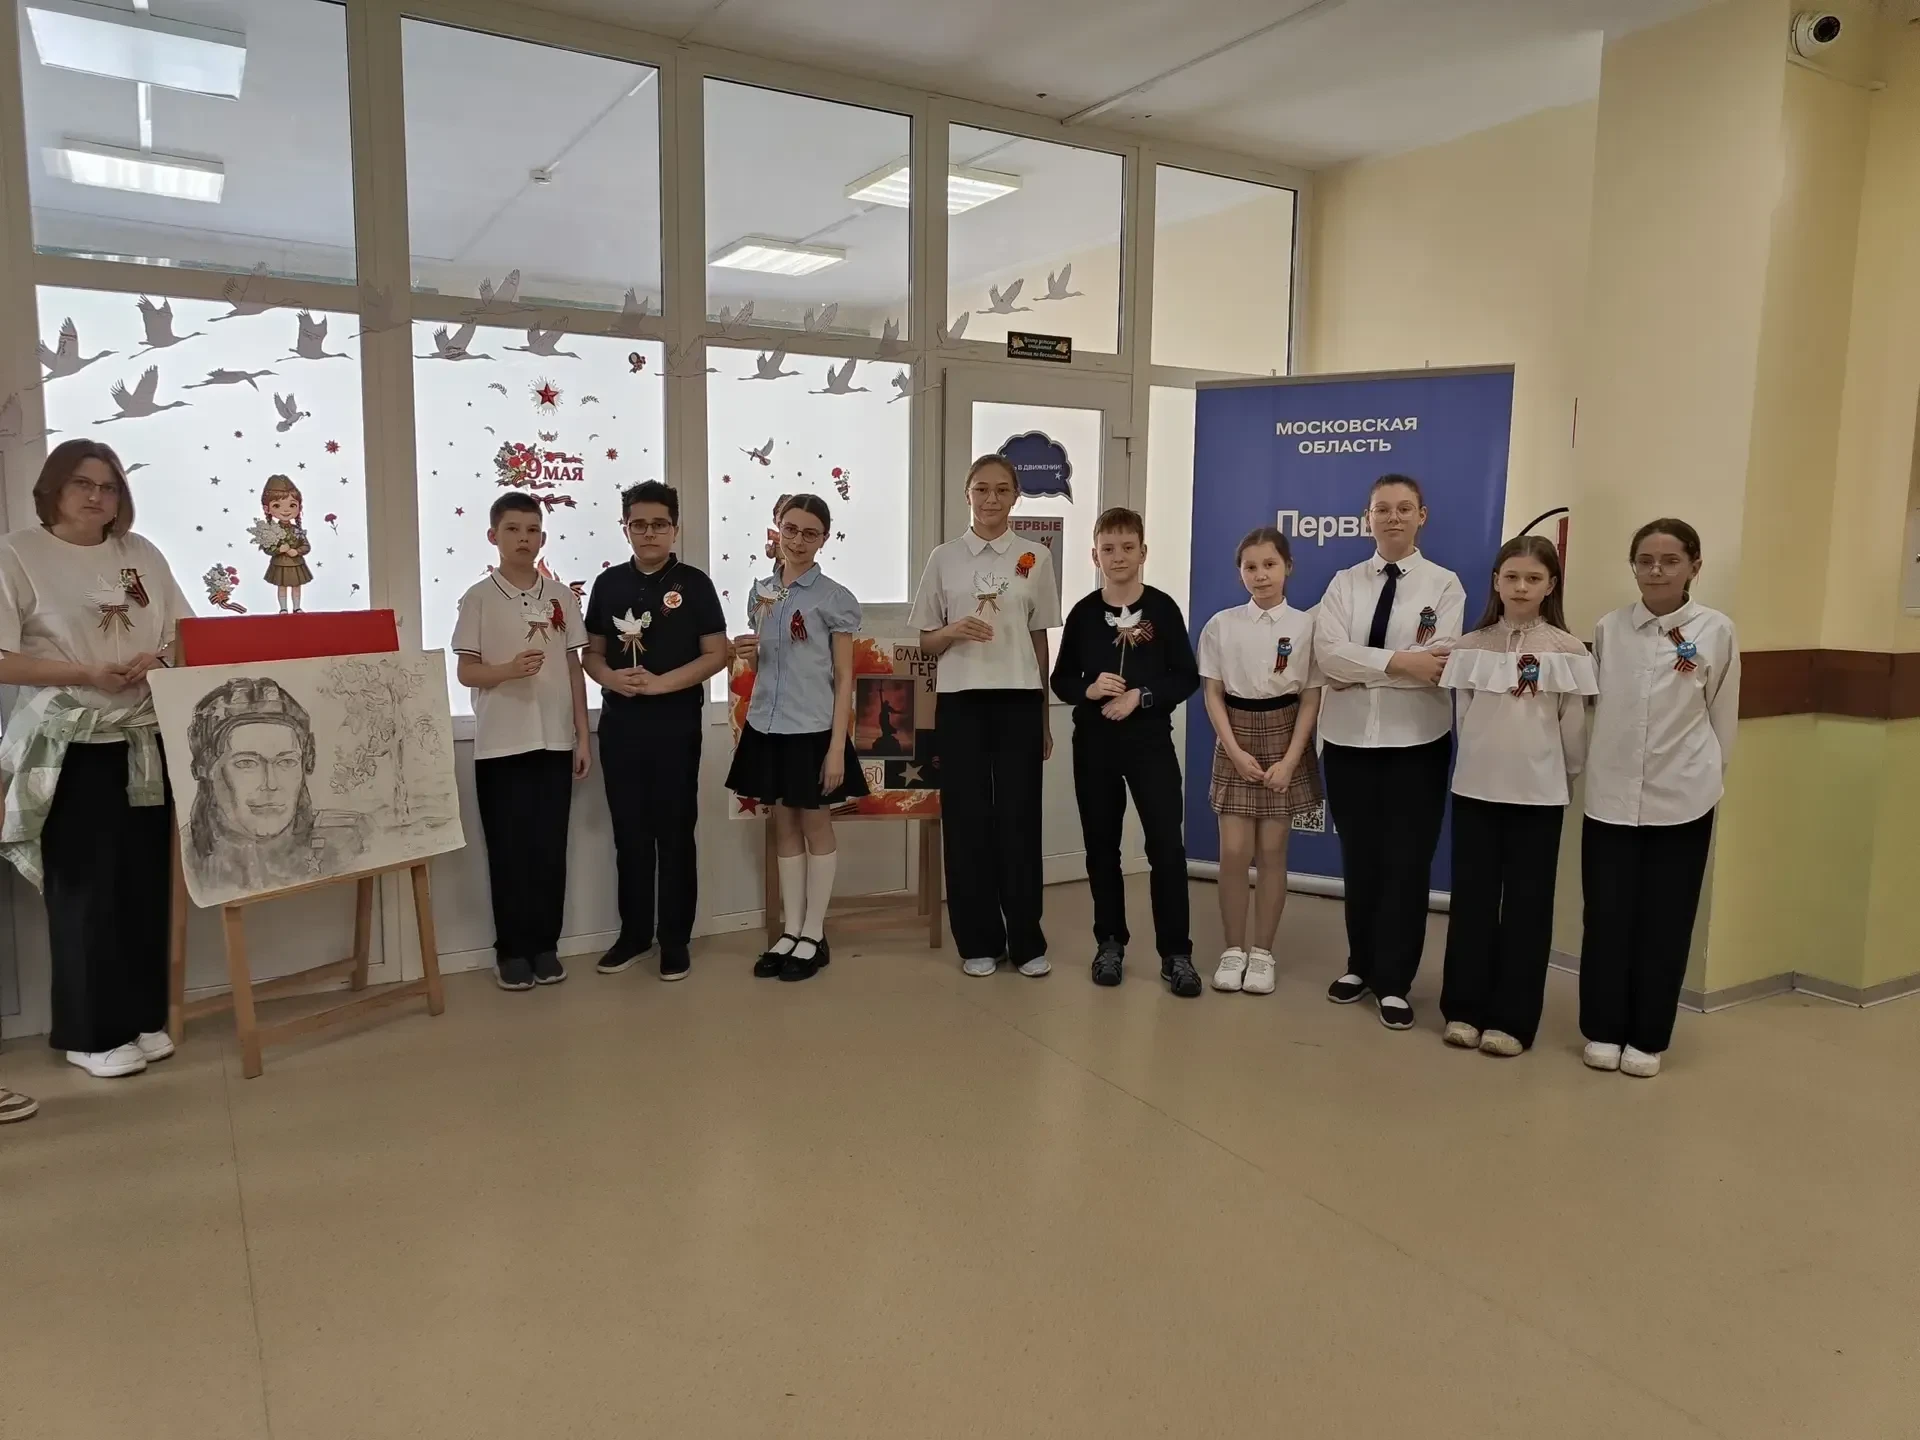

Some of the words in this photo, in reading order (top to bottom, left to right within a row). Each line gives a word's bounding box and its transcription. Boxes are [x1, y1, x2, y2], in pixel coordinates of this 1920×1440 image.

[1275, 417, 1418, 435] МОСКОВСКАЯ
[1298, 438, 1392, 454] ОБЛАСТЬ
[526, 457, 542, 479] 9
[543, 466, 584, 481] МАЯ
[910, 662, 937, 677] ГЕР
[926, 678, 937, 692] Я
